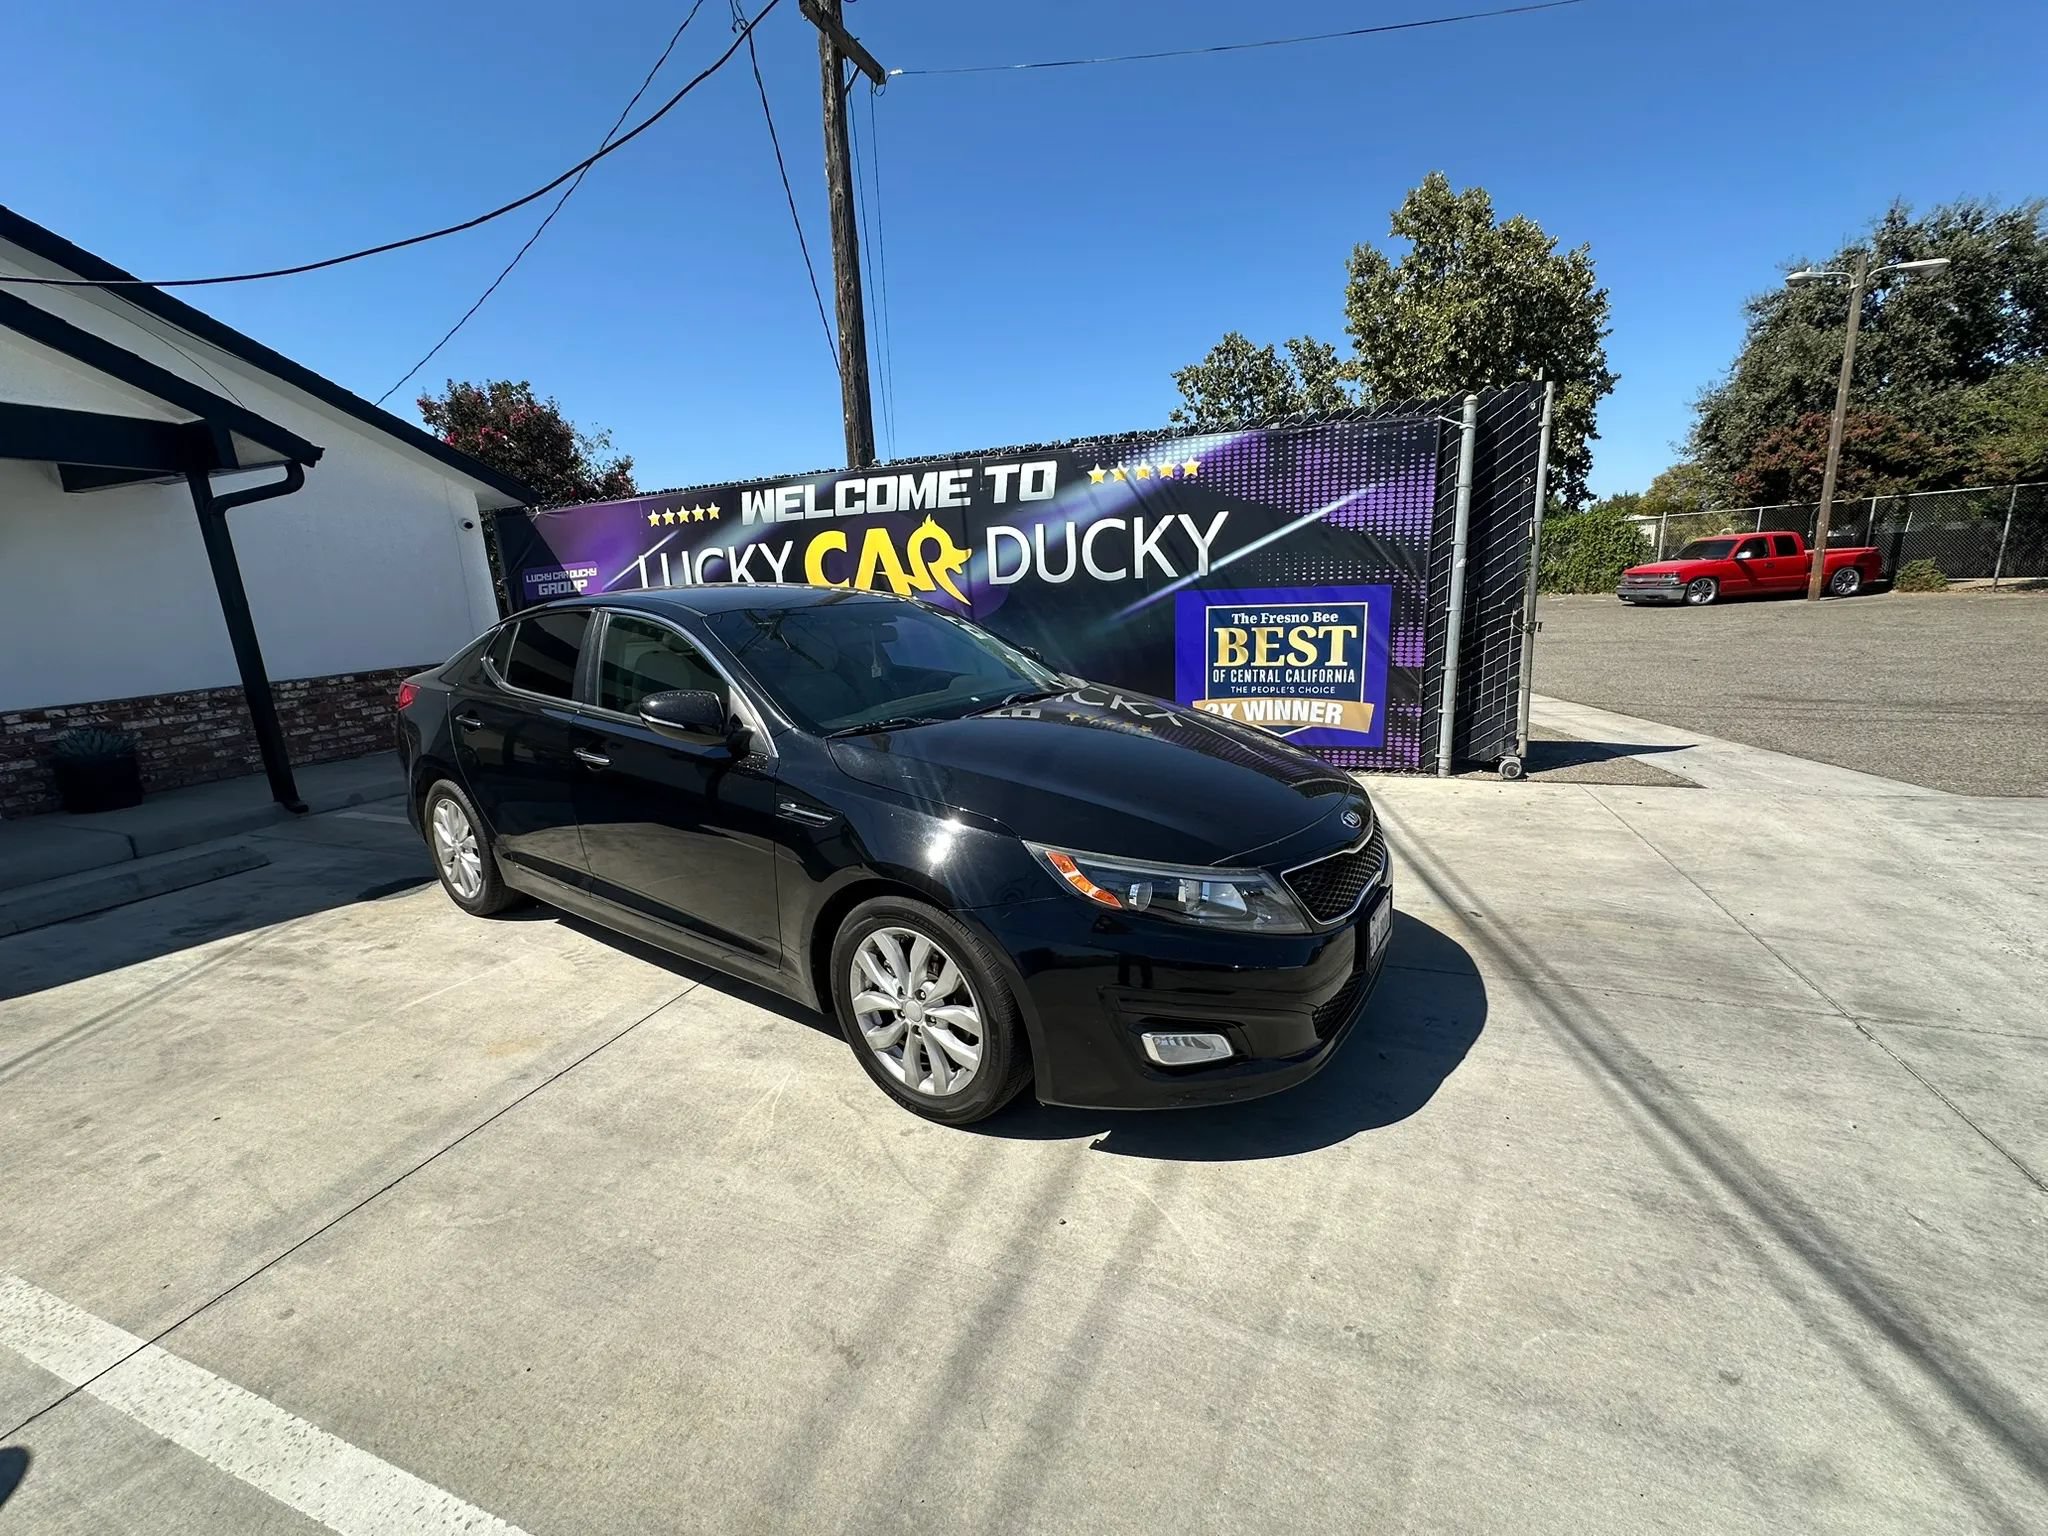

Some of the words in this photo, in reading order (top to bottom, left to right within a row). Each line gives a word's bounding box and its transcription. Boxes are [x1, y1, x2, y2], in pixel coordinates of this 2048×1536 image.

[740, 468, 974, 526] WELCOME
[984, 460, 1058, 504] TO
[804, 513, 973, 606] CAR
[986, 511, 1229, 585] DUCKY
[525, 572, 552, 583] LUCKY
[569, 567, 598, 579] DUCKY
[538, 579, 588, 595] GROUP
[1231, 612, 1258, 625] The
[1260, 612, 1309, 624] Fresno
[1311, 611, 1339, 624] Bee
[1213, 625, 1358, 668] BEST
[1212, 670, 1227, 684] OF
[1230, 669, 1281, 684] CENTRAL
[1285, 668, 1356, 684] CALIFORNIA
[1231, 686, 1248, 694] THE
[1250, 685, 1295, 694] PEOPLE'S
[1298, 685, 1336, 694] CHOICE
[1240, 700, 1344, 726] WINNER
